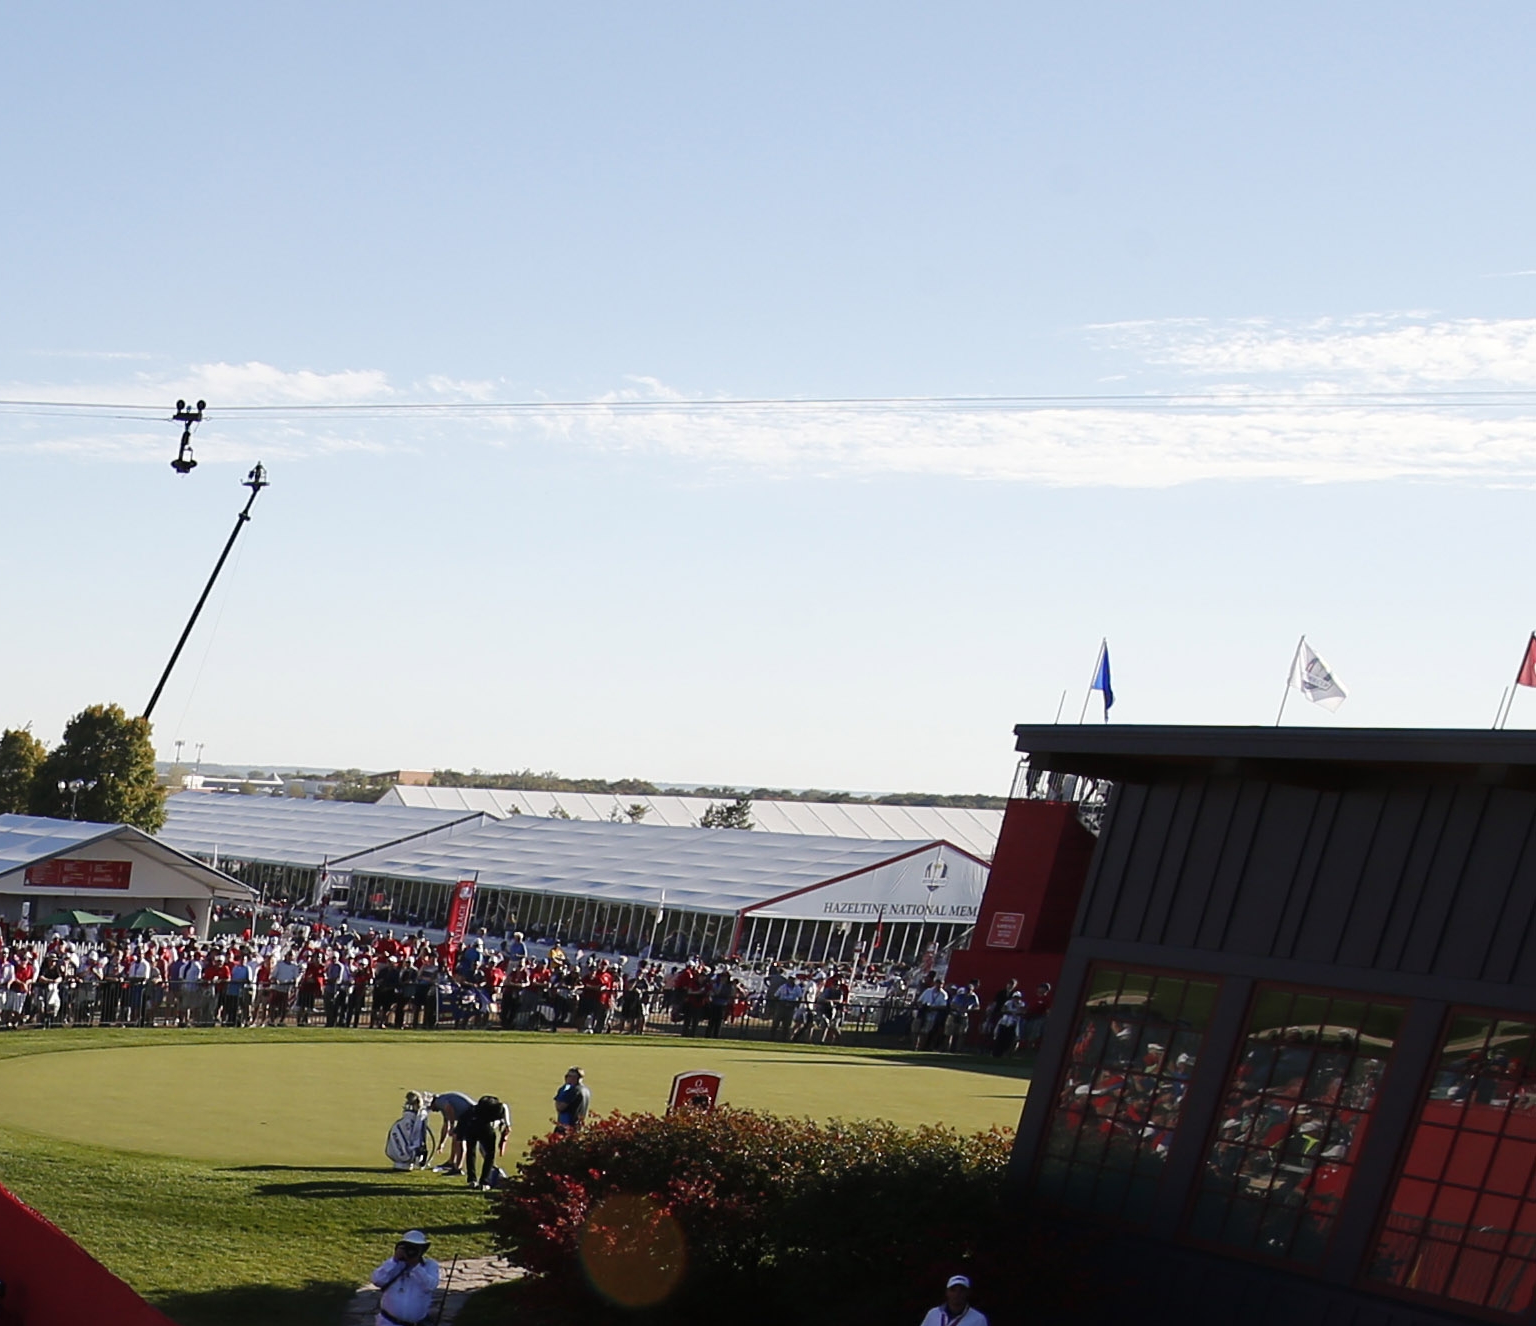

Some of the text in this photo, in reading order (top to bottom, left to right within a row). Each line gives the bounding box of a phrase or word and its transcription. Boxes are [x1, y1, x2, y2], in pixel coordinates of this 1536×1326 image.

[823, 902, 978, 917] HAZELTINE NATIONAL MEM
